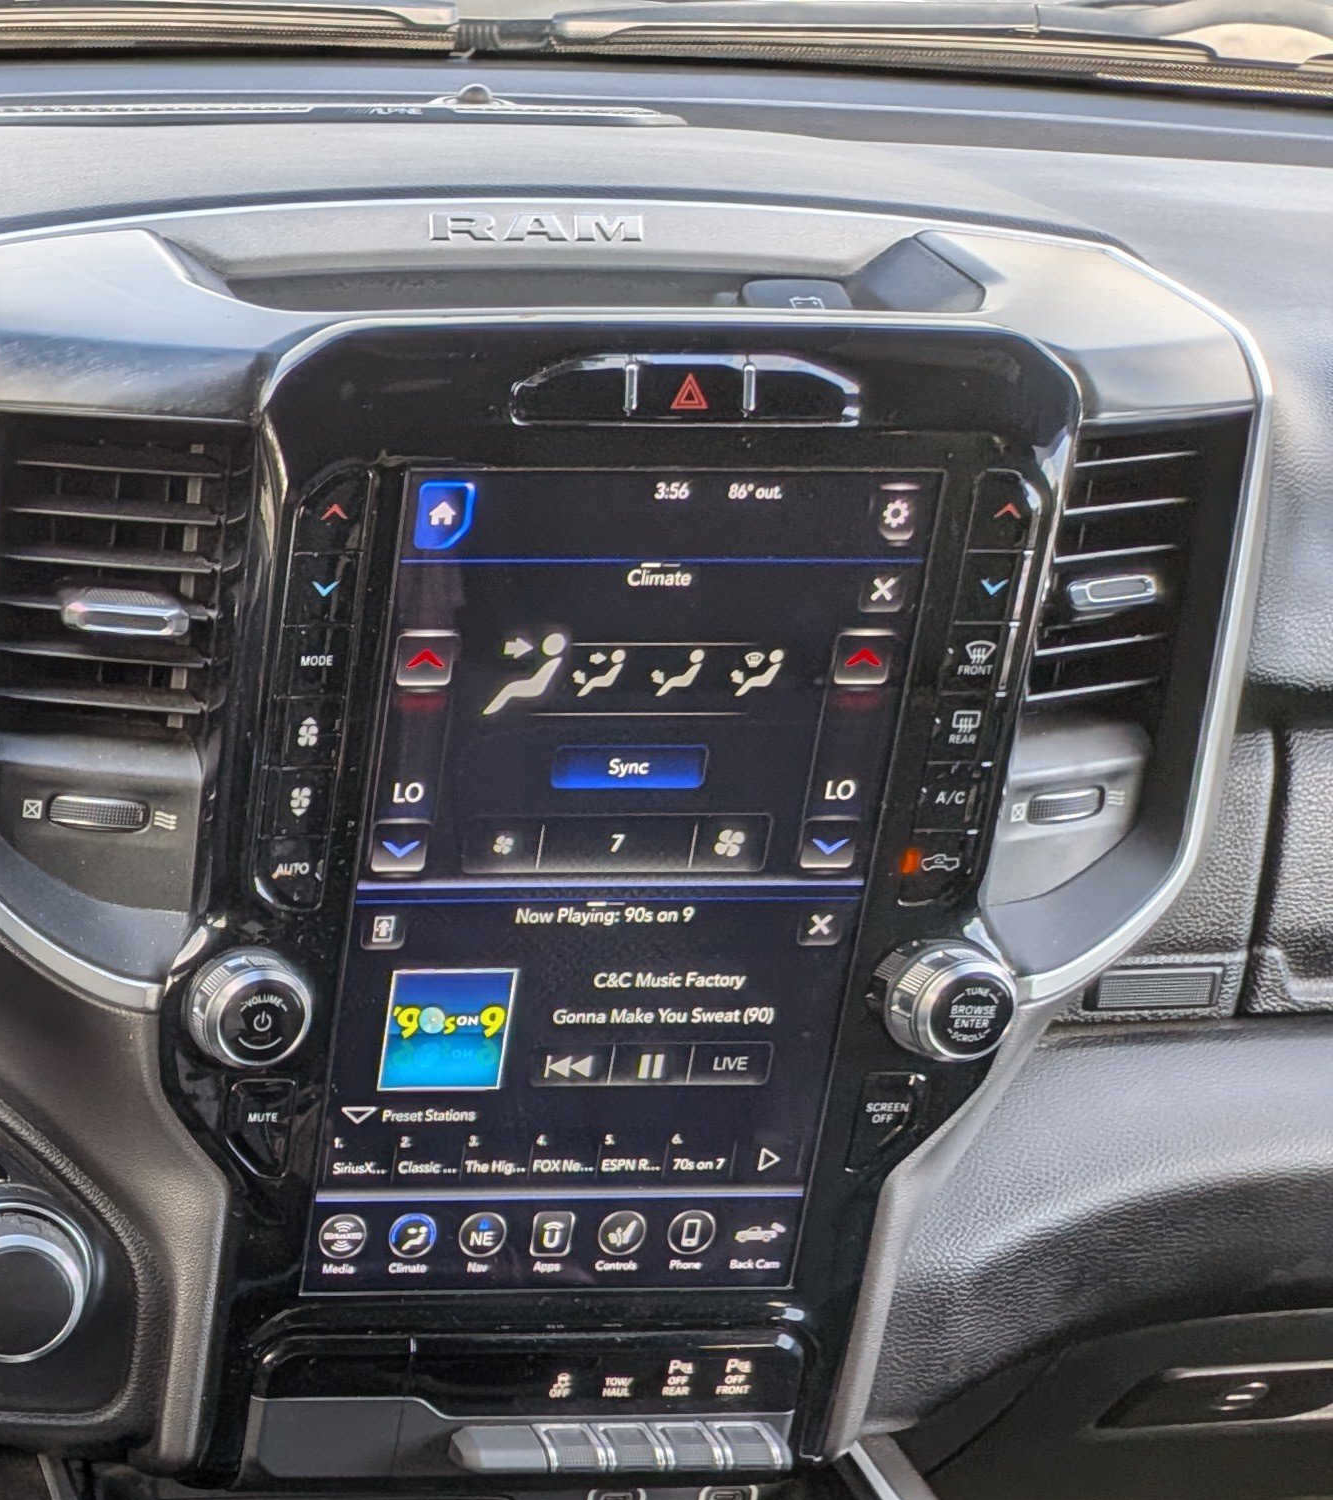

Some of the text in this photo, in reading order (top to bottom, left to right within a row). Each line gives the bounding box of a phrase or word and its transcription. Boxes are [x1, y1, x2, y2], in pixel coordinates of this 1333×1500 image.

[428, 212, 643, 242] RAM
[654, 482, 690, 500] 3:56
[627, 569, 692, 587] Climate
[300, 655, 334, 667] MODE
[957, 665, 993, 675] FRONT
[948, 734, 977, 744] REAR
[608, 757, 649, 778] Sync
[393, 782, 424, 803] LO
[824, 779, 856, 802] LO
[935, 791, 966, 805] A/C
[611, 833, 625, 853] 7
[276, 862, 309, 875] AUTO
[515, 906, 695, 926] Now Playing: 90s on 9
[594, 971, 747, 990] C&C Music Factory
[965, 987, 990, 998] TUNE
[246, 994, 283, 1008] VOLUME
[553, 1007, 775, 1025] Gonna Make You Sweat (90)
[951, 1005, 997, 1016] BROWSE
[456, 1015, 479, 1027] ON
[480, 1005, 506, 1039] 9
[953, 1018, 990, 1028] ENTER
[951, 1032, 986, 1042] SCROLL
[713, 1056, 748, 1071] LIVE
[865, 1102, 910, 1113] SCREEN
[247, 1112, 278, 1122] MUTE
[382, 1108, 477, 1123] Preset Stations
[872, 1114, 894, 1123] OFF
[465, 1160, 489, 1174] The
[533, 1158, 561, 1172] FOX
[601, 1158, 636, 1172] ESPN
[673, 1157, 726, 1171] 70s on 7
[469, 1231, 496, 1247] NE
[323, 1263, 357, 1275] Media
[389, 1262, 428, 1274] Climate
[467, 1261, 489, 1273] Nav
[533, 1261, 562, 1274] Apps
[595, 1261, 637, 1272] Controls
[669, 1259, 702, 1271] Phone
[729, 1259, 754, 1270] Back
[667, 1376, 689, 1386] OFF
[724, 1375, 746, 1385] OFF
[549, 1388, 571, 1398] OFF
[602, 1387, 630, 1398] HAUL
[662, 1386, 690, 1396] REAR
[715, 1385, 751, 1395] FRONT
